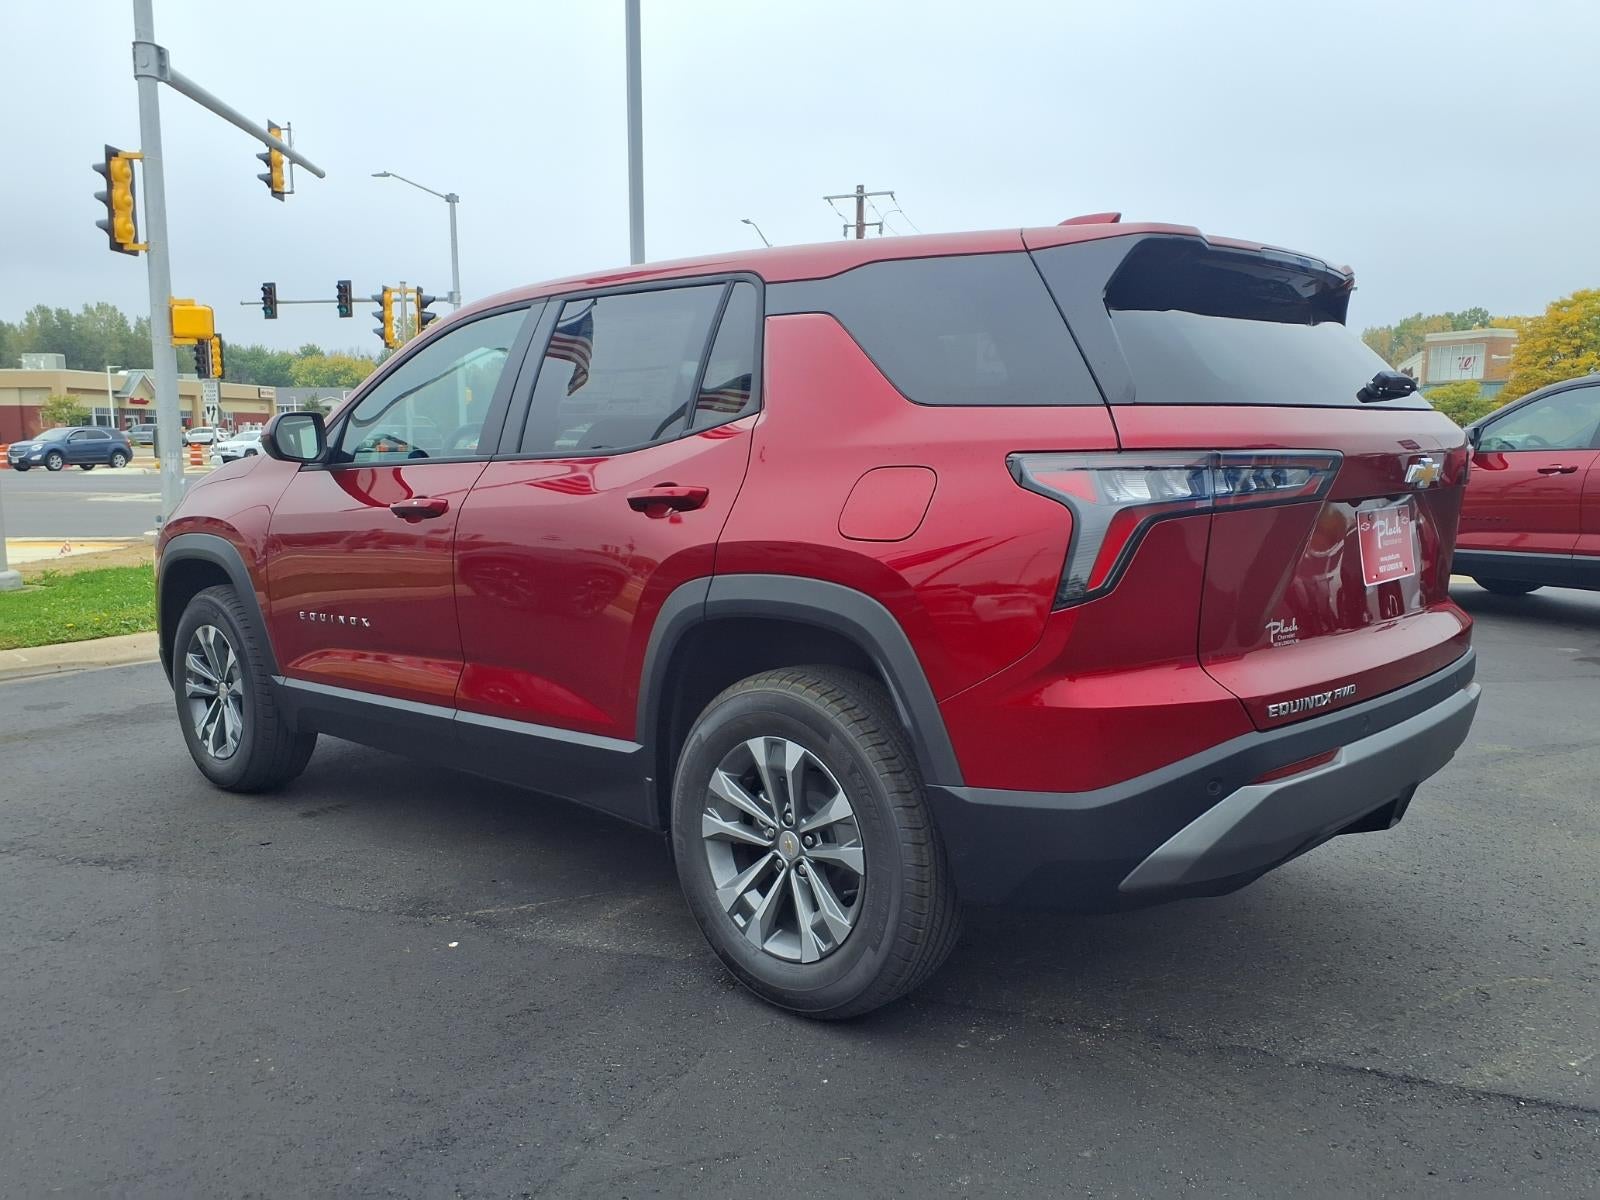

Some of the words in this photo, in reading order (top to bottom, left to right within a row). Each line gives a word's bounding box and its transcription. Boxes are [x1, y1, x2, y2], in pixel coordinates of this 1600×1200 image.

[299, 611, 370, 627] EQUINOX
[1268, 691, 1333, 717] EQUINOX
[1333, 684, 1356, 700] AWD
